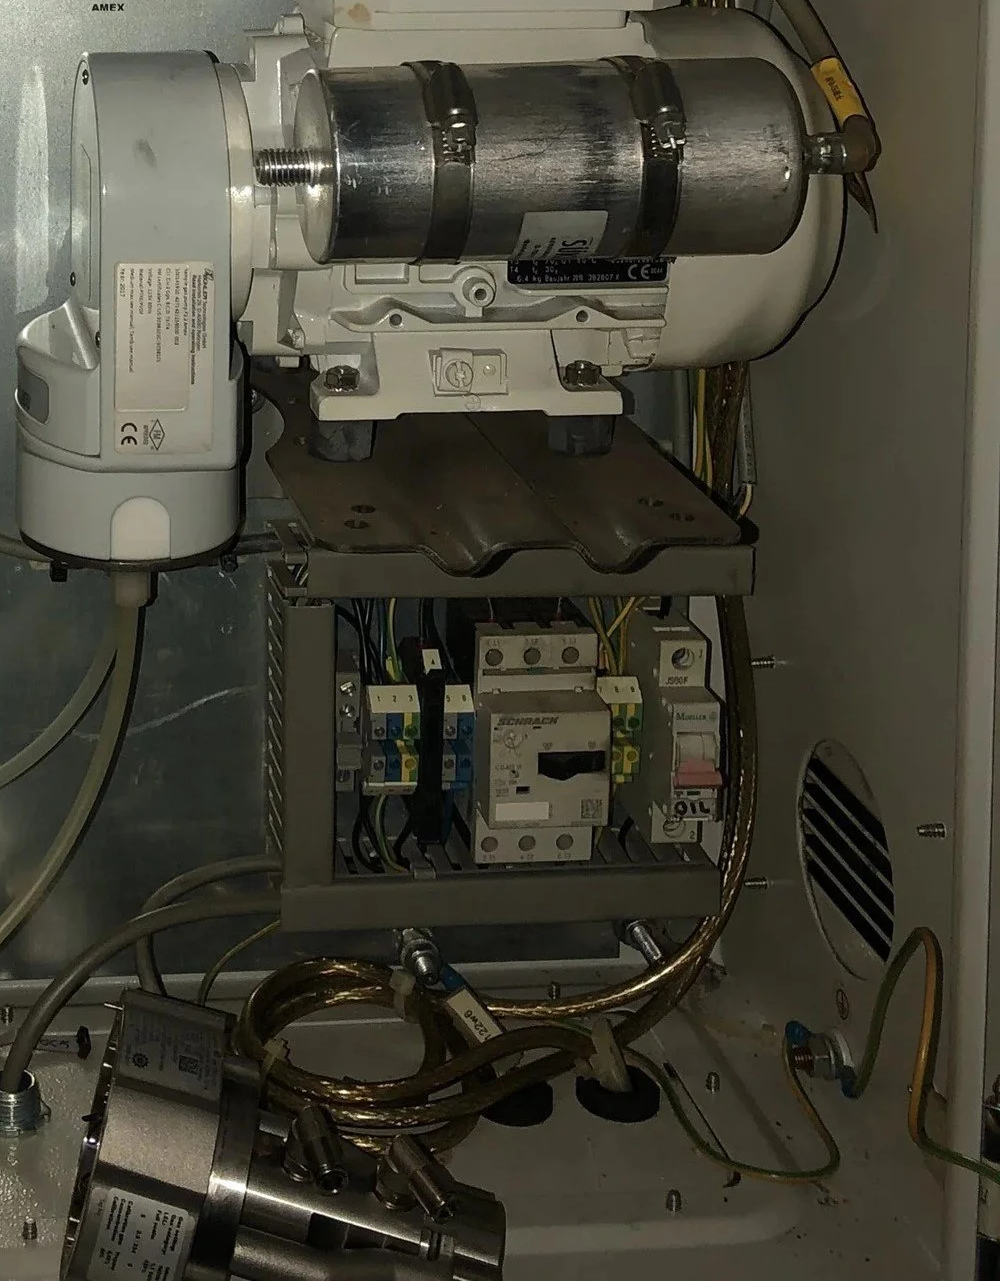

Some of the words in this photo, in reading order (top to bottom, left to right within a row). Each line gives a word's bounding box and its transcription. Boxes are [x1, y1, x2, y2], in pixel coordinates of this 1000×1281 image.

[91, 3, 125, 12] AMEX
[497, 716, 559, 726] SCHRACK
[674, 801, 711, 815] OIL
